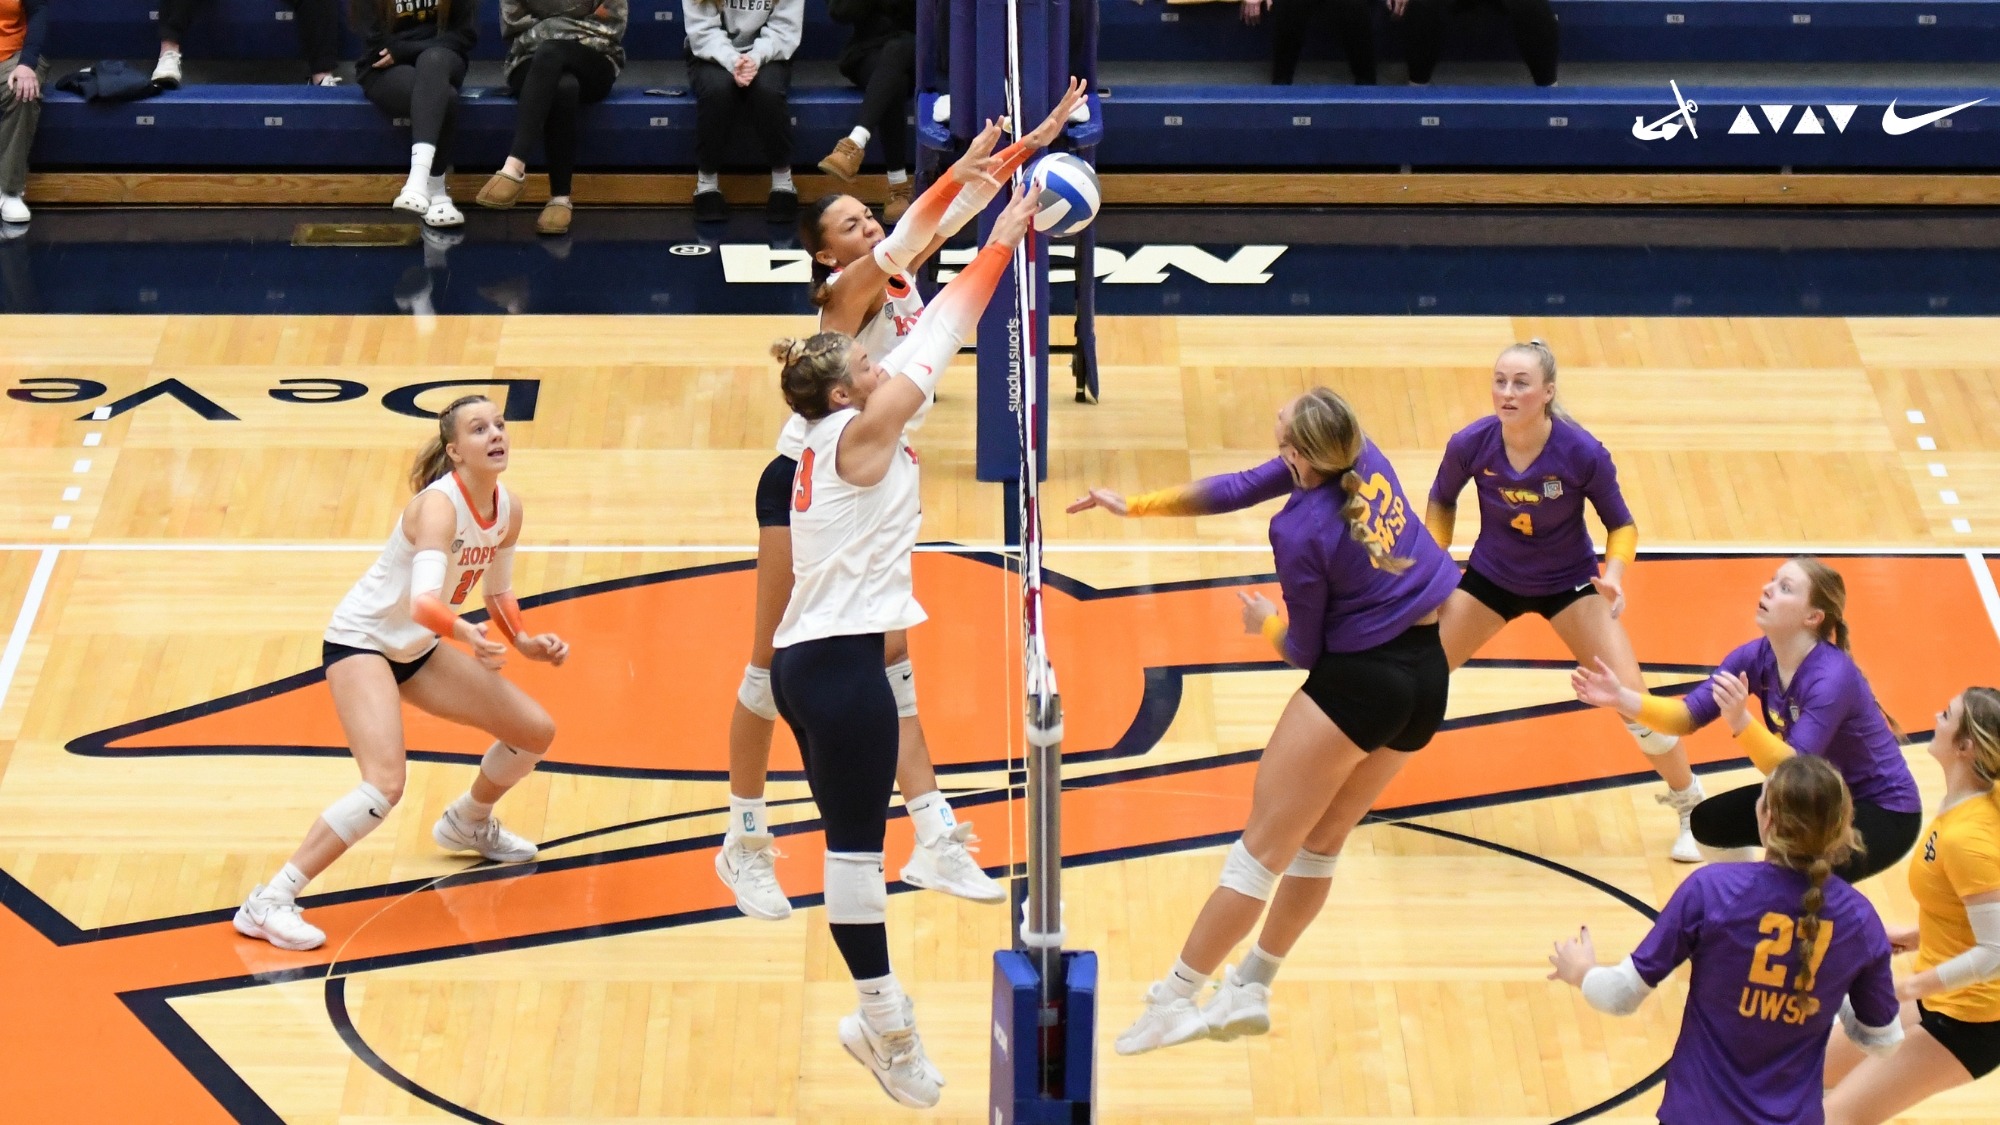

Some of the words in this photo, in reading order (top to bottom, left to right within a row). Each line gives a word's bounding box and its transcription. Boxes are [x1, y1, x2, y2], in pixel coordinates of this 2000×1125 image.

[725, 0, 772, 11] LLEGE
[719, 244, 1289, 284] NCA
[1510, 512, 1533, 536] 4
[1748, 911, 1834, 992] 27
[1738, 986, 1821, 1025] UWSP
